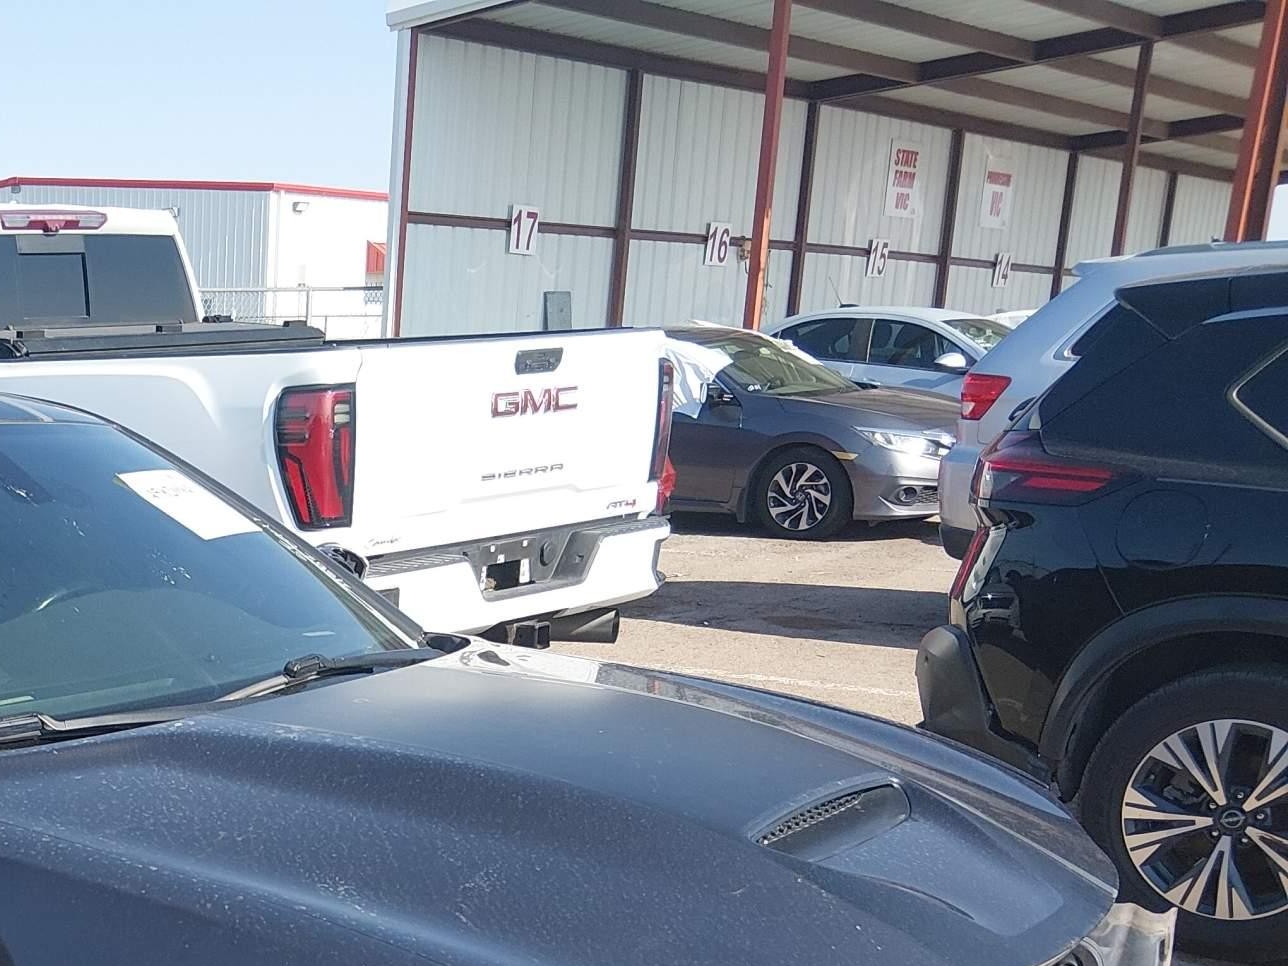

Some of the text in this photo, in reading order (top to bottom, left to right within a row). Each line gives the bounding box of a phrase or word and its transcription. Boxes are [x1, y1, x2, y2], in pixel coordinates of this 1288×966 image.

[894, 148, 919, 169] STATE
[892, 169, 916, 189] FARM
[513, 209, 539, 251] 17
[710, 226, 730, 263] 16
[871, 241, 889, 276] 15
[996, 254, 1011, 286] 14
[491, 385, 578, 418] GMC
[480, 463, 564, 482] SIERRA
[606, 498, 637, 510] AT4
